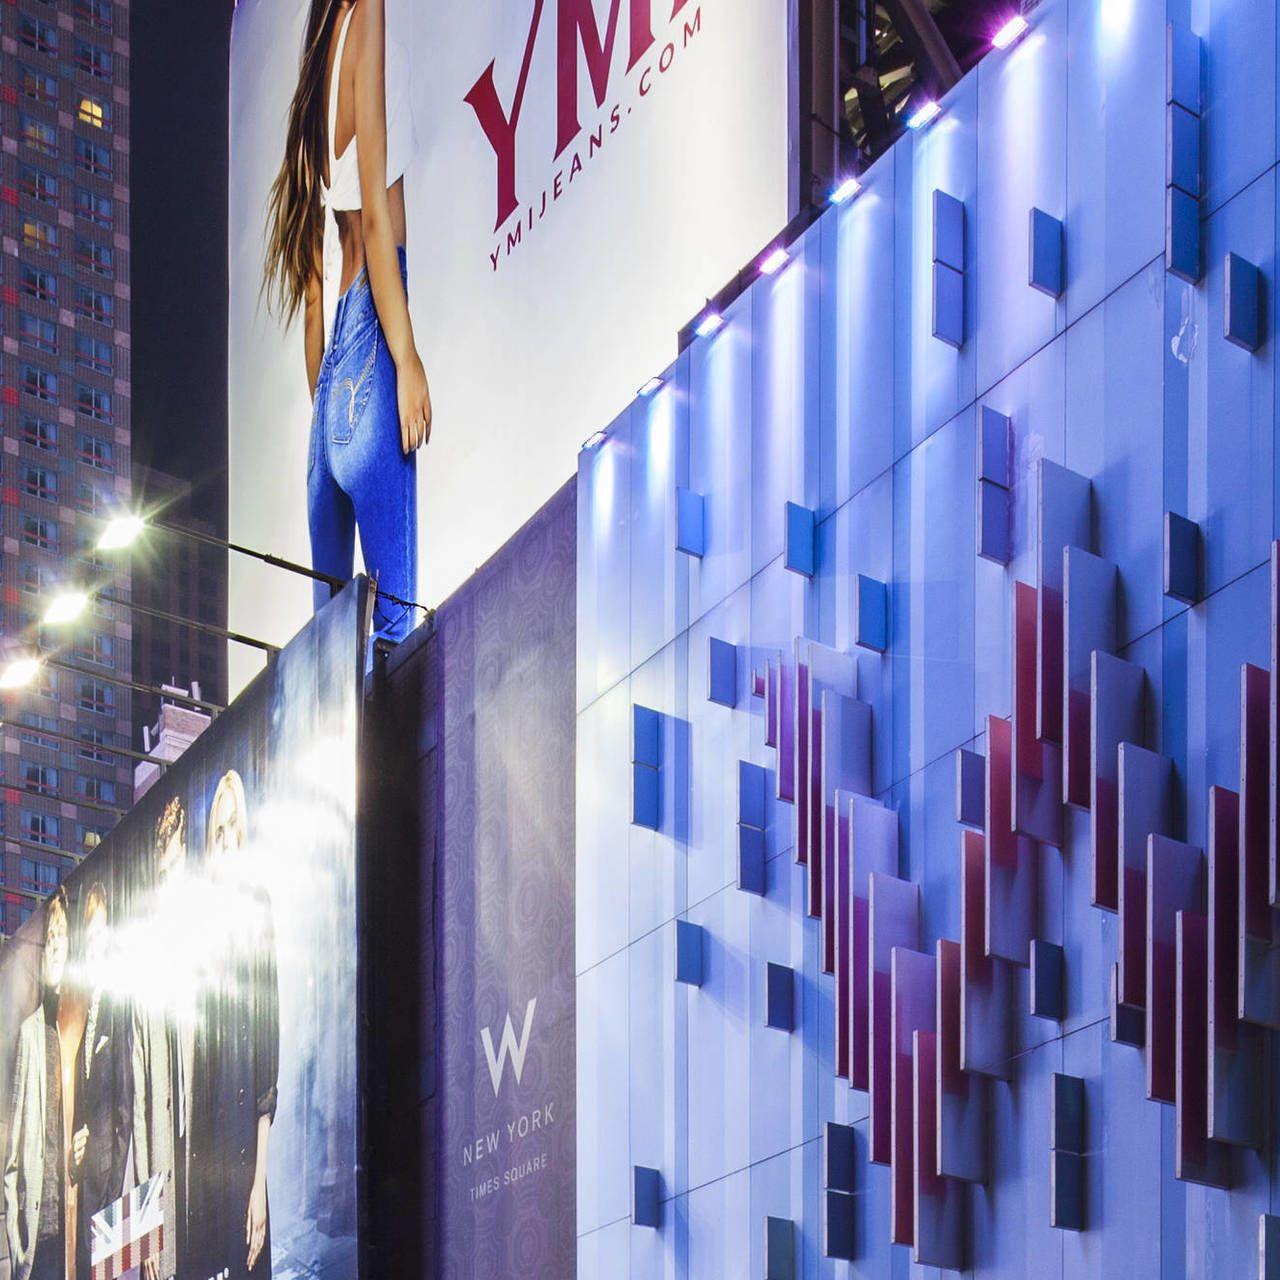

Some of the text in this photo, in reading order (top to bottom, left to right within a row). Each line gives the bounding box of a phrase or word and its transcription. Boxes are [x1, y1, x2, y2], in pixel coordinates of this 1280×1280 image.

[463, 0, 688, 233] YM
[489, 7, 701, 271] YMIJEANS.COM
[480, 998, 536, 1098] W
[463, 1103, 554, 1168] NEW YORK
[470, 1153, 548, 1201] TIMES SQUARE
